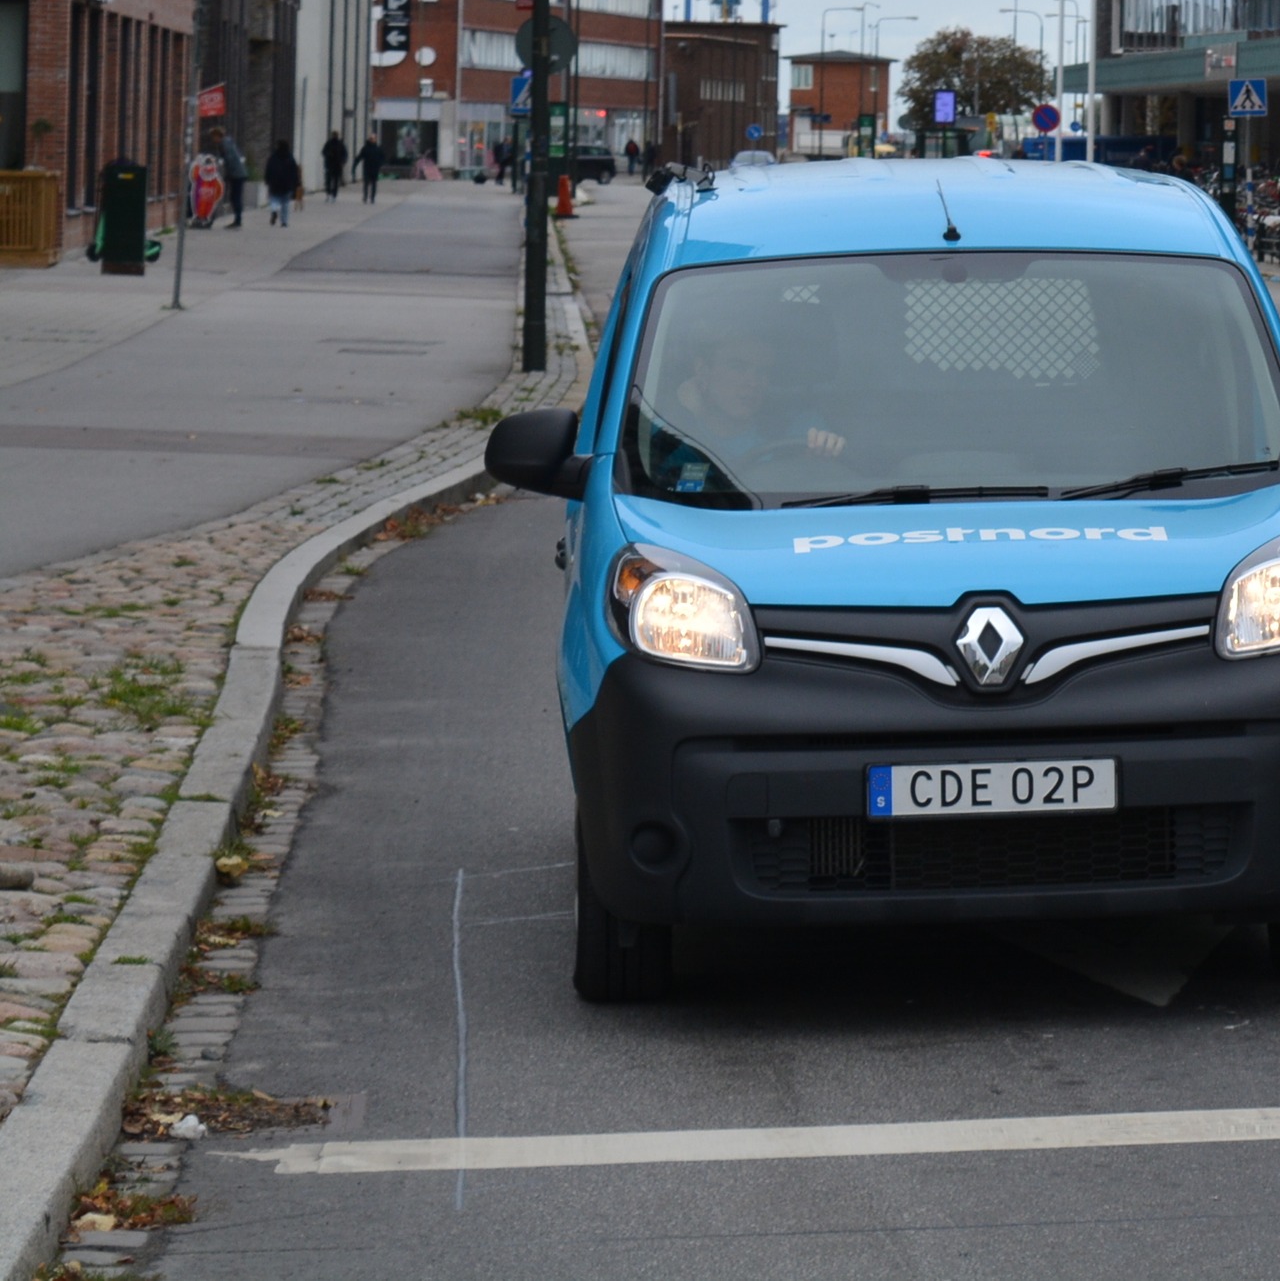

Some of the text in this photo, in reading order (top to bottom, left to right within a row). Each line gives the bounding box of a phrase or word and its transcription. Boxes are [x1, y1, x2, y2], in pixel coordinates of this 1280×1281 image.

[792, 526, 1169, 555] postnord
[876, 764, 1095, 808] S CDE 02P
